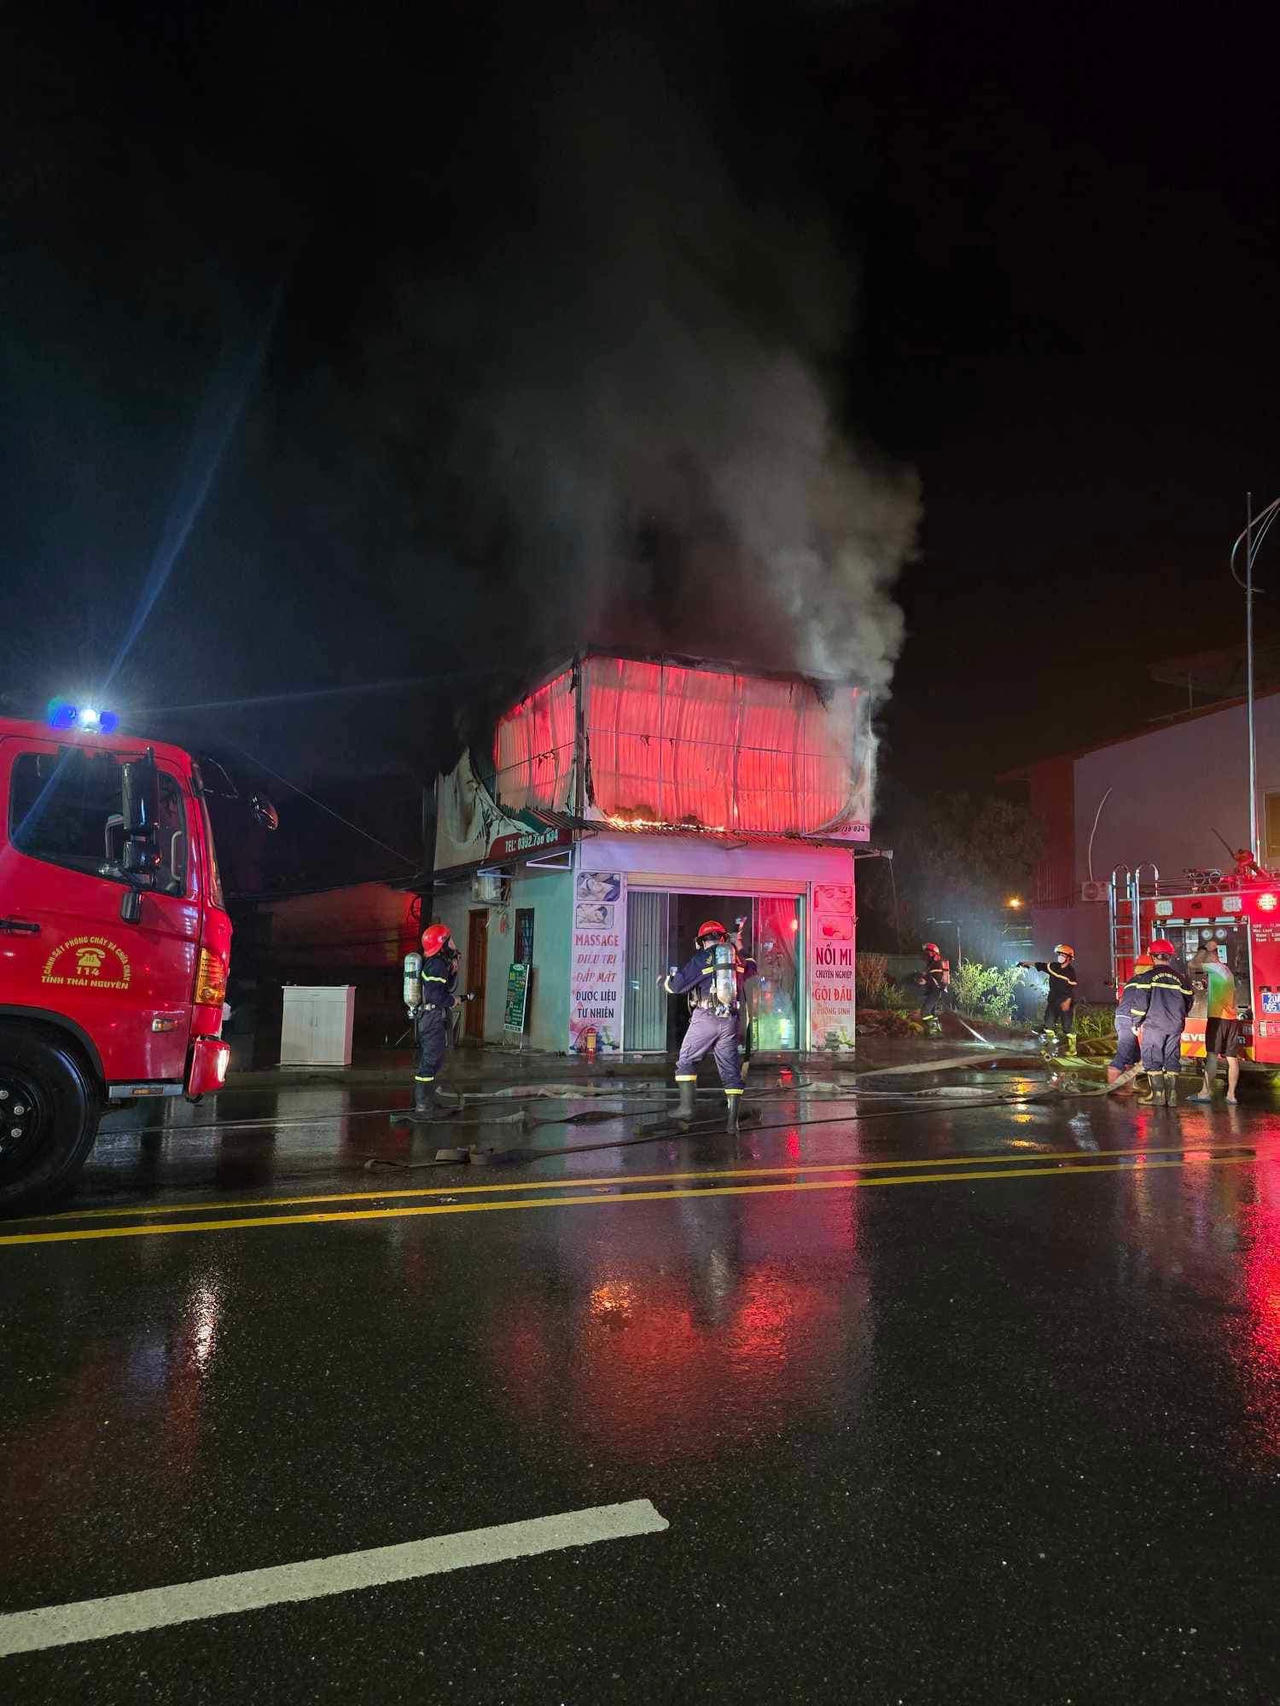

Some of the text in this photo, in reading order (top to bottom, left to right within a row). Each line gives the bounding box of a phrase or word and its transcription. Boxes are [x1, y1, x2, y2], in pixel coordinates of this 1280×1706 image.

[575, 934, 619, 947] MASSAGE
[815, 941, 852, 966] NỐI MI
[76, 966, 101, 976] 114
[601, 988, 617, 1004] LIỆU
[590, 1006, 615, 1019] NHIÊN
